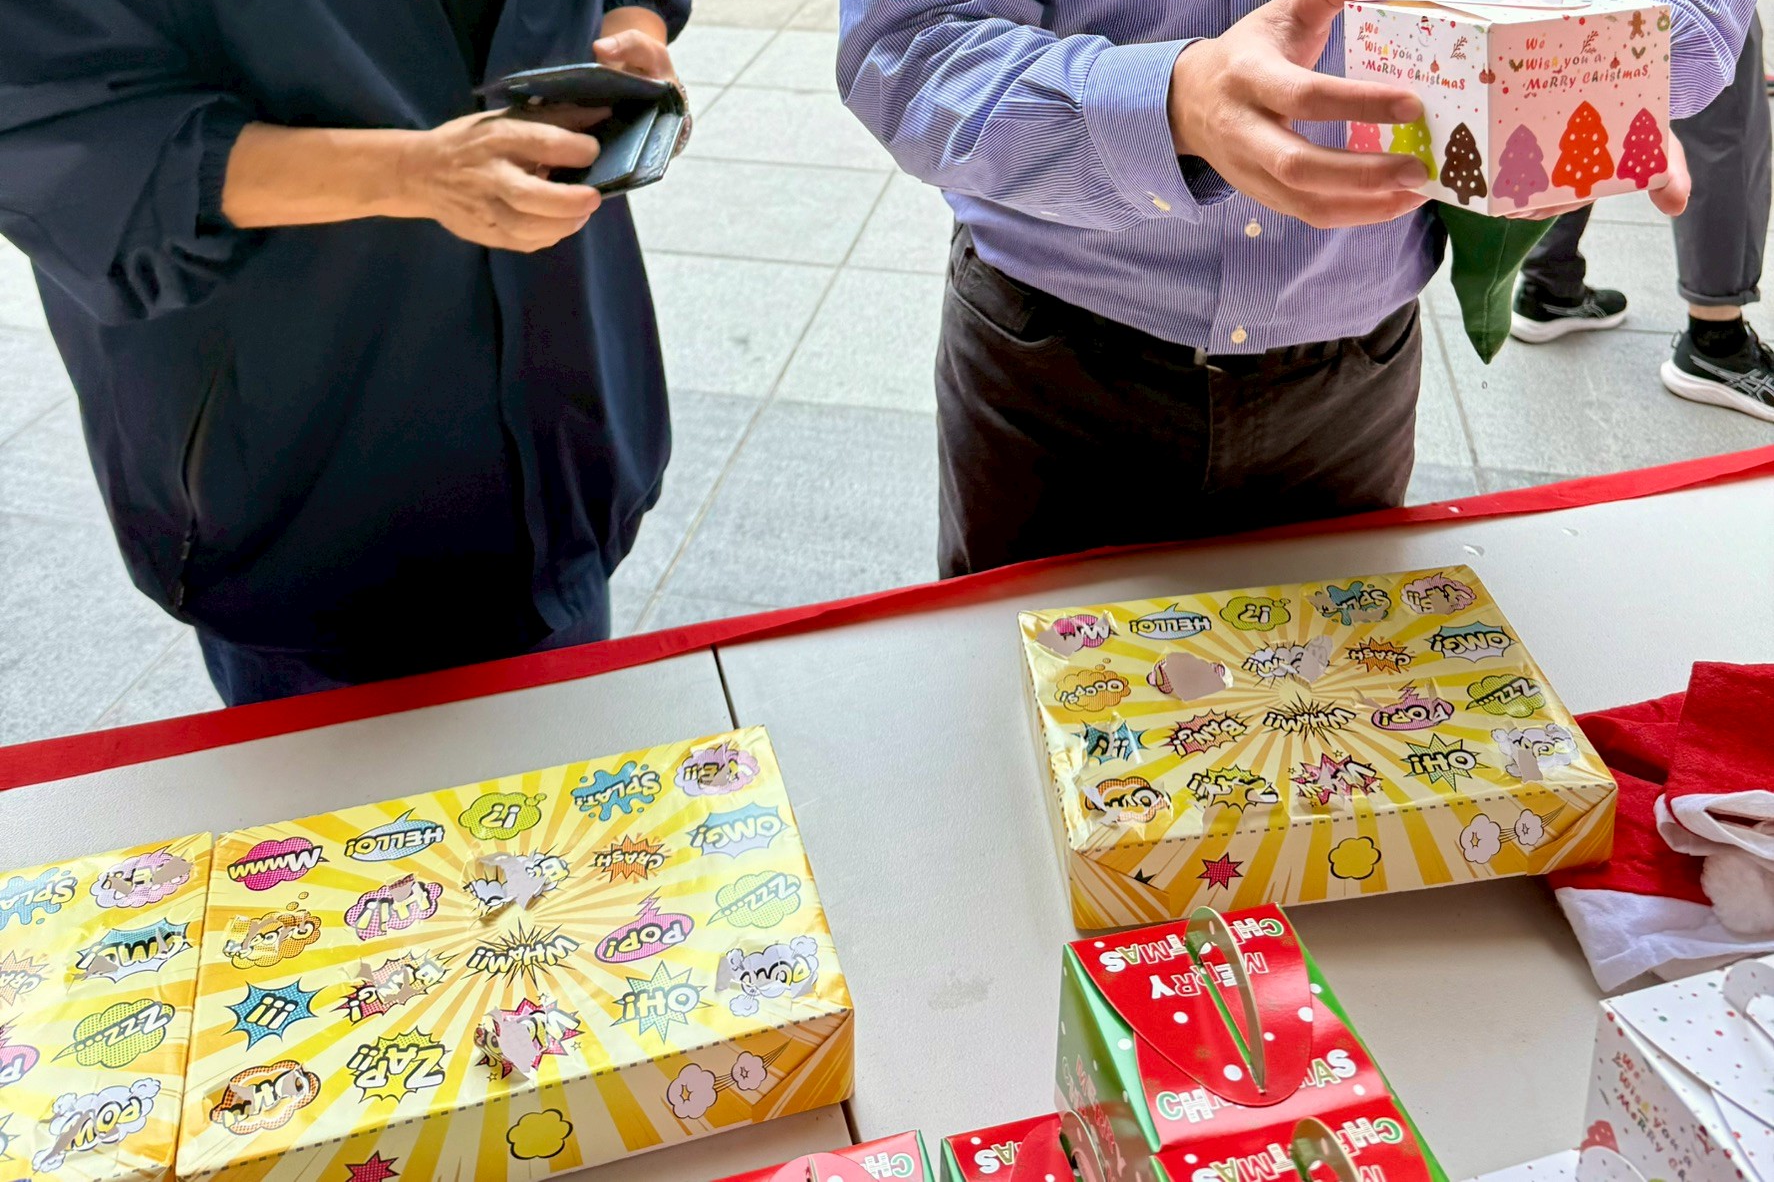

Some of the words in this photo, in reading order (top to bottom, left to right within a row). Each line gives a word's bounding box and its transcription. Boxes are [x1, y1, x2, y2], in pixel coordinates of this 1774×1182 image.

[1392, 48, 1412, 60] you
[1416, 53, 1423, 62] a
[1564, 55, 1588, 67] you
[1594, 53, 1602, 63] a
[1130, 615, 1212, 633] HELLO!
[1430, 631, 1511, 654] OMG!
[1266, 707, 1356, 732] WHAM!!
[1381, 703, 1451, 727] POP!
[1172, 717, 1245, 756] BANG!
[1410, 751, 1477, 774] OH!
[345, 822, 444, 858] HELLO!
[694, 814, 782, 850] OMG!
[471, 935, 580, 973] WHAM!!
[606, 922, 686, 958] POP!
[623, 982, 700, 1017] OH!
[346, 1043, 447, 1090] ZAP!!
